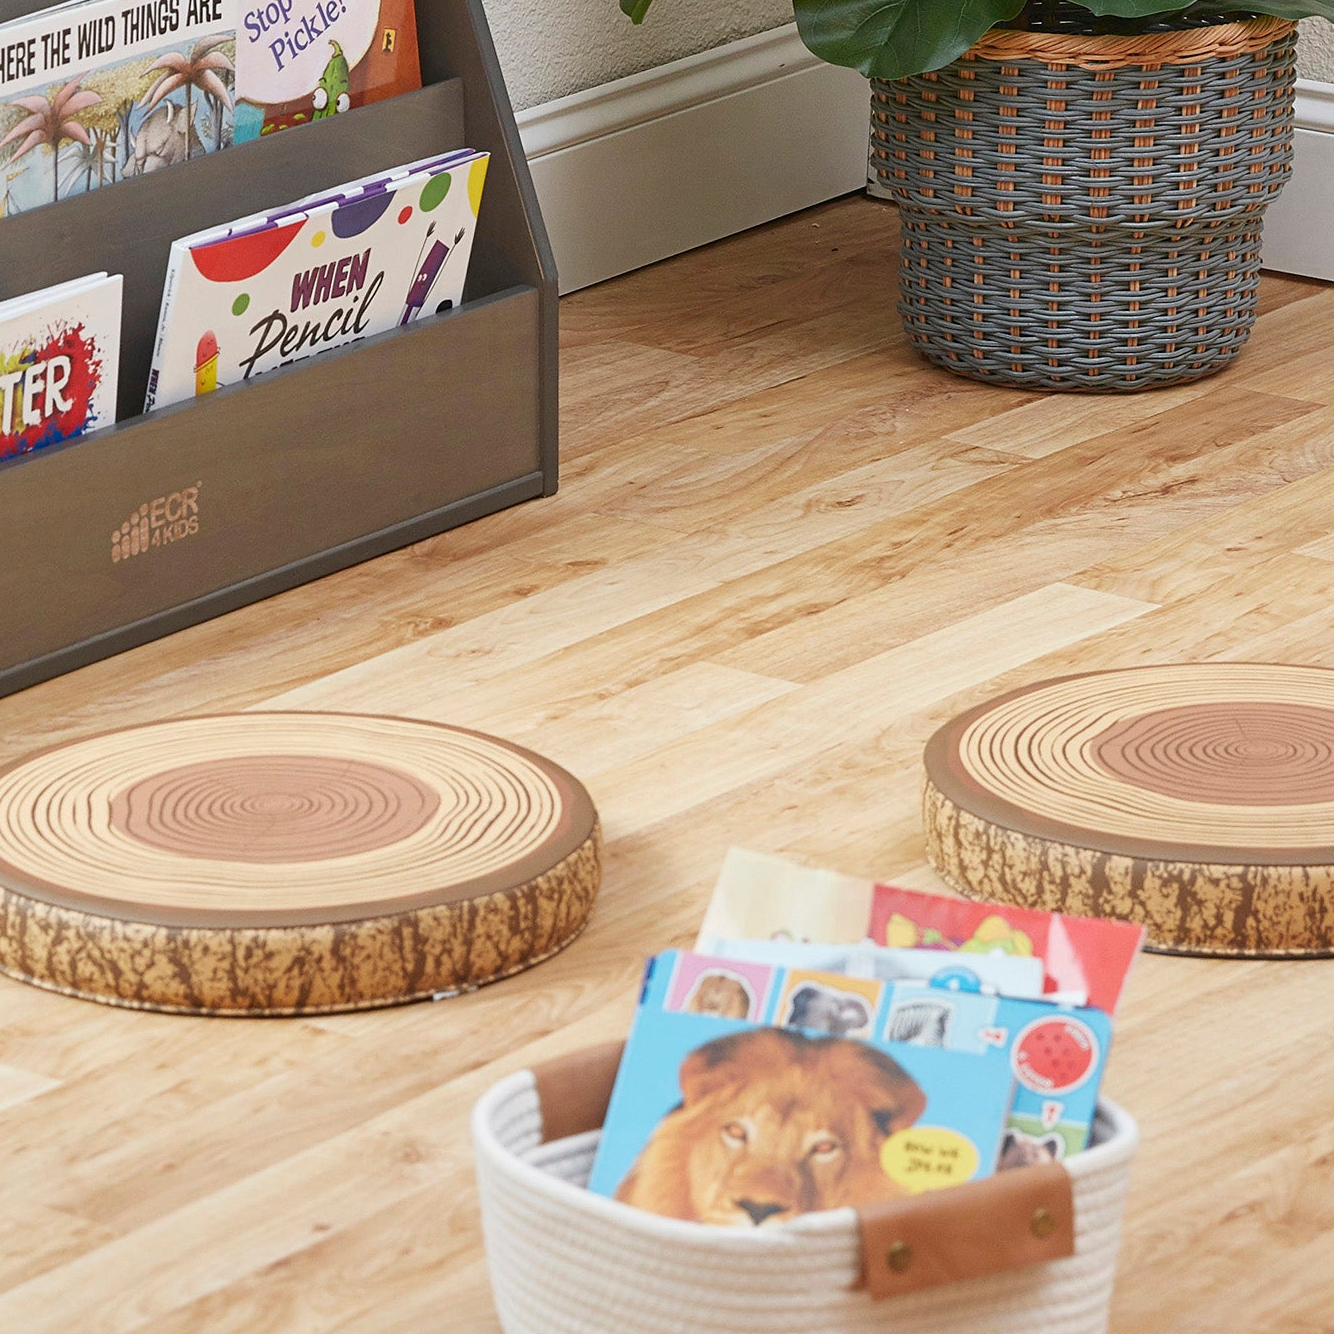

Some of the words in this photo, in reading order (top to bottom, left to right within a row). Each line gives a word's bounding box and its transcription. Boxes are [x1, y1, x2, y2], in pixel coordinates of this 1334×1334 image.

[40, 27, 73, 72] THE
[76, 15, 116, 62] WILD
[121, 0, 181, 48] THINGS
[289, 248, 371, 313] WHEN
[239, 270, 385, 380] Pencil
[150, 486, 199, 529] ECR
